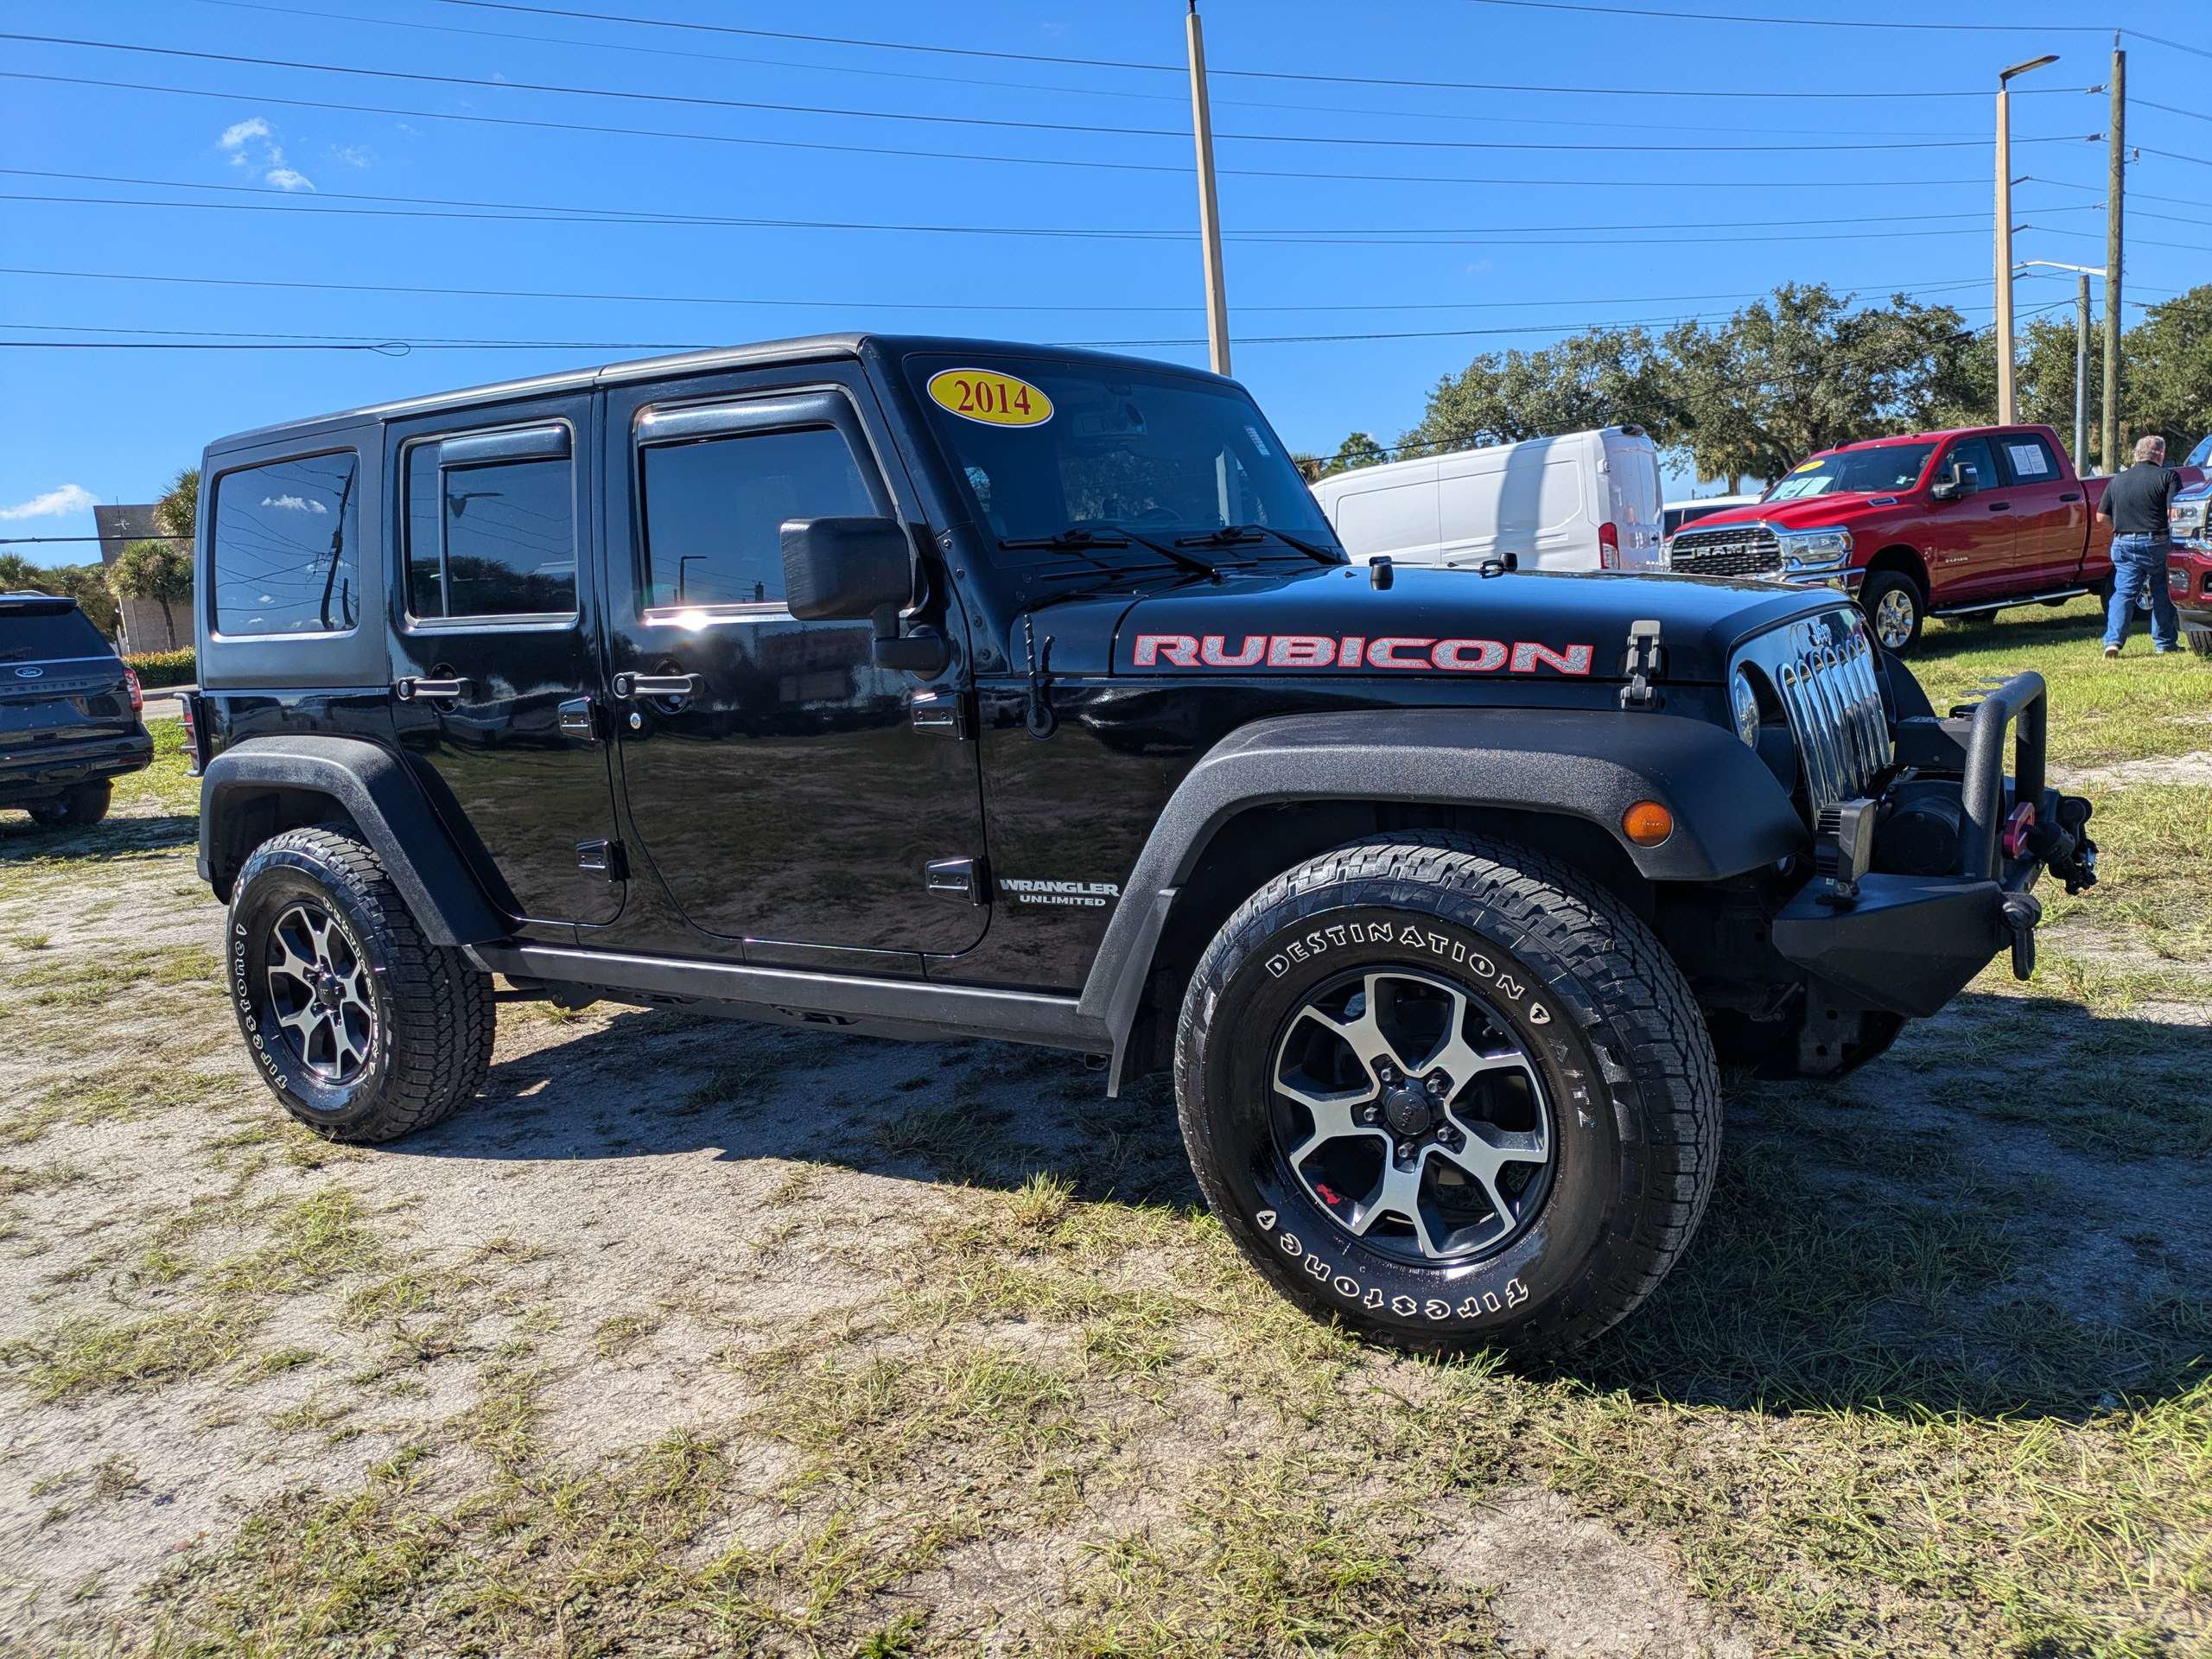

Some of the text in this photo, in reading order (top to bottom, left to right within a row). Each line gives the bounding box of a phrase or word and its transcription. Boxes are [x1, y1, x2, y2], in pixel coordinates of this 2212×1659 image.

[954, 380, 1031, 416] 2014
[1697, 544, 1743, 557] RAM
[1133, 635, 1596, 675] RUBICON
[999, 879, 1120, 897] WRANGLER
[1020, 894, 1106, 906] UNLIMITED
[322, 896, 379, 1058] DESTINATION
[1264, 921, 1527, 1001] DESTINATION
